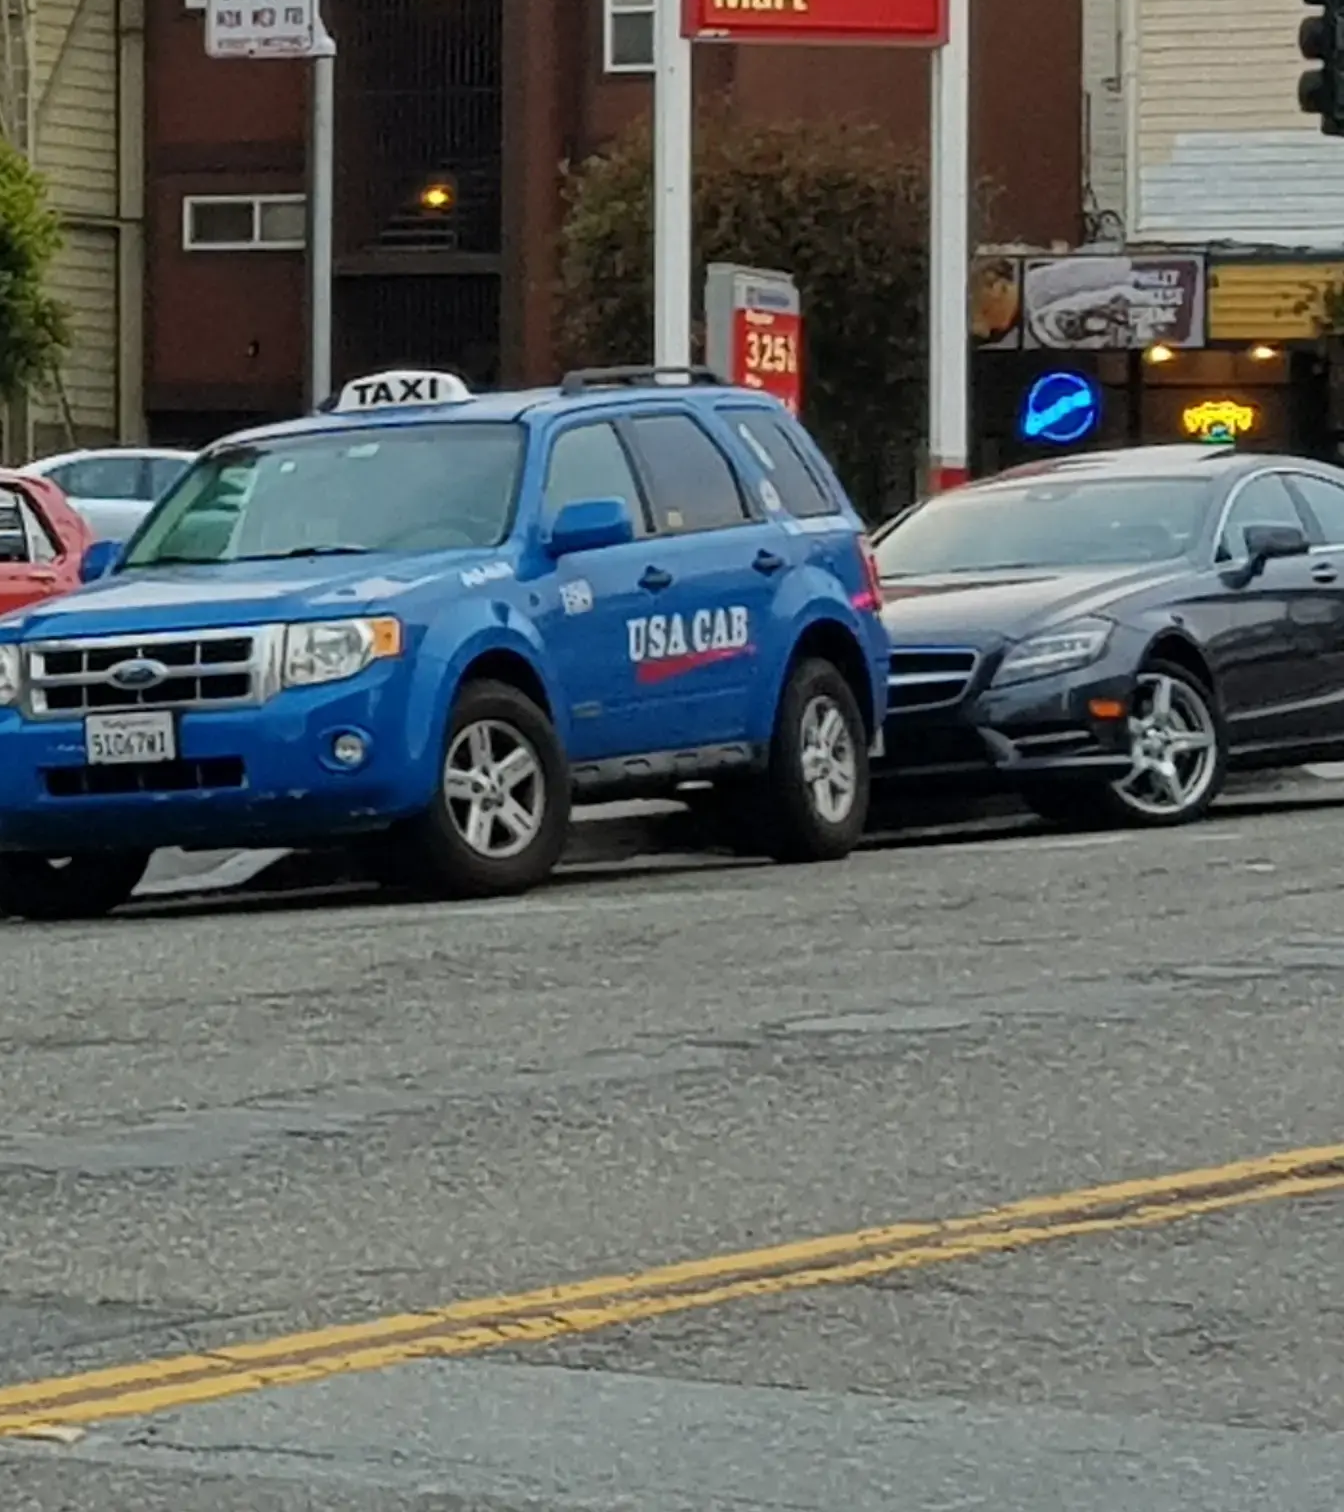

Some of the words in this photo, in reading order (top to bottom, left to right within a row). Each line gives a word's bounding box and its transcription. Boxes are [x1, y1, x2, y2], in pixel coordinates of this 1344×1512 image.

[745, 331, 787, 373] 325
[352, 377, 439, 405] TAXI
[626, 611, 689, 663] USA
[693, 605, 749, 653] CAB
